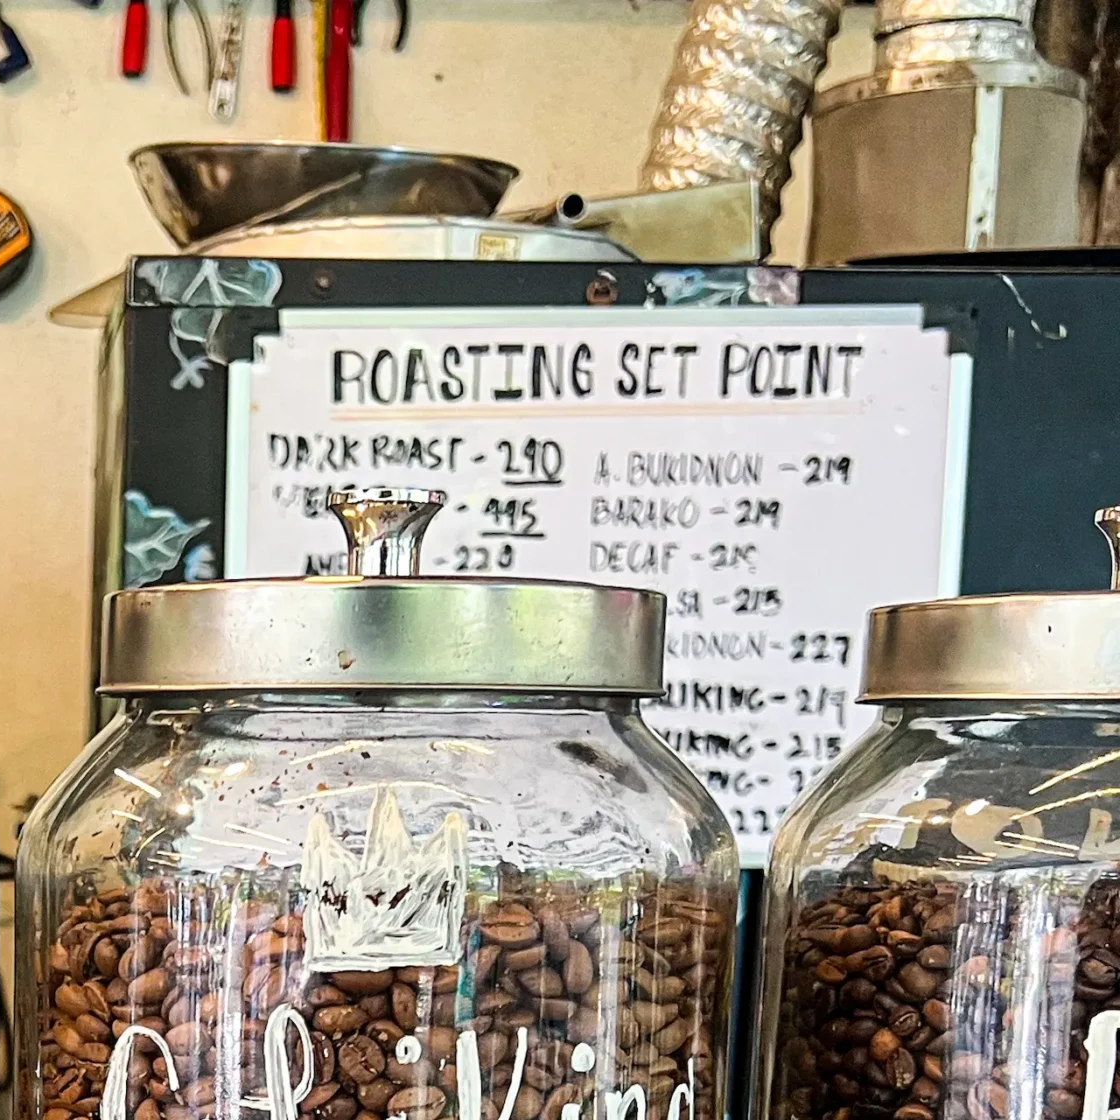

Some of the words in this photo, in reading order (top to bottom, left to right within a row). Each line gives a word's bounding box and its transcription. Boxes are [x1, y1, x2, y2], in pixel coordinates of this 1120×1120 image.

[332, 345, 592, 404] ROASTING
[618, 343, 698, 397] SET
[721, 343, 863, 397] POINT
[268, 434, 358, 471] DARK
[370, 435, 464, 471] ROAST
[627, 451, 764, 486] BUKIDNON
[590, 496, 701, 529] BARAKO
[589, 541, 680, 574] DECAF
[790, 631, 851, 667] 227
